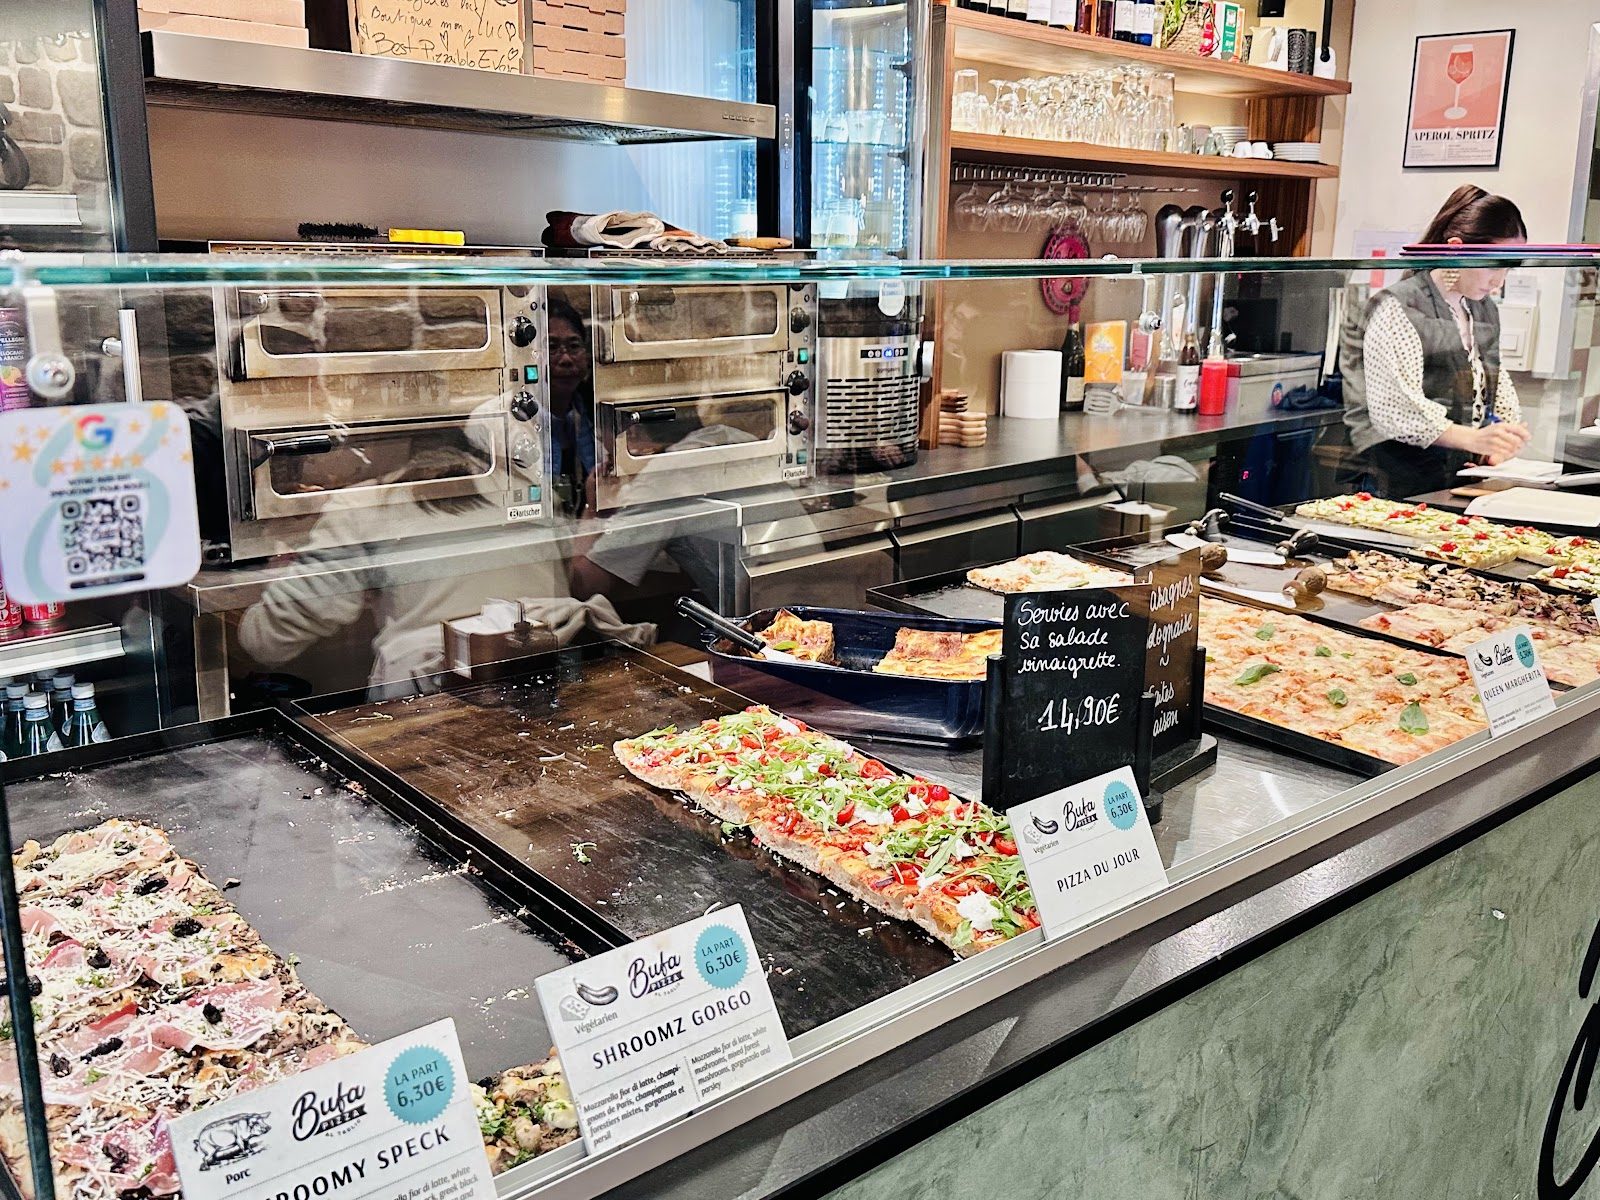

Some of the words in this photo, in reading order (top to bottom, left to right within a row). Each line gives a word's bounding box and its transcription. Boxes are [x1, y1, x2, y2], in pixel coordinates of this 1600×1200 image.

[370, 32, 419, 56] Best
[1413, 131, 1453, 142] APEROL
[1455, 129, 1496, 141] SPRITZ
[1017, 601, 1079, 626] Servies
[1085, 601, 1130, 620] avec
[1048, 626, 1109, 649] salade
[1017, 650, 1121, 680] vinaigrette.
[1483, 684, 1505, 701] QUEEN
[1504, 668, 1542, 690] MARGHERITA
[1037, 692, 1121, 735] 14,90€
[1152, 709, 1179, 738] aison
[1107, 795, 1117, 804] LA
[1115, 791, 1129, 802] PART
[1110, 801, 1135, 819] 6,30€
[1062, 797, 1096, 832] Bufa
[1056, 868, 1092, 892] PIZZA
[1093, 860, 1110, 877] DU
[1113, 848, 1141, 869] JOUR
[701, 946, 714, 957] LA
[713, 936, 734, 952] PART
[627, 951, 682, 999] Bufa
[705, 949, 743, 975] 6,30€
[574, 1011, 618, 1035] Végétarien
[592, 1017, 687, 1070] SHROOMZ
[691, 990, 752, 1027] GORGO
[691, 1046, 722, 1065] Mozzarella
[721, 1042, 731, 1054] fior
[731, 1038, 738, 1047] di
[737, 1033, 753, 1044] latte,
[752, 1026, 767, 1037] white
[694, 1056, 728, 1075] mushrooms,
[727, 1046, 744, 1060] mixed
[743, 1040, 760, 1055] forest
[394, 1073, 410, 1086] LA
[411, 1060, 439, 1080] PART
[697, 1066, 731, 1085] mushrooms,
[730, 1051, 760, 1072] gorgonzola
[759, 1044, 771, 1056] and
[396, 1075, 448, 1108] 6,30€
[583, 1092, 619, 1113] Mozzarella
[619, 1087, 631, 1100] fior
[631, 1083, 639, 1092] di
[639, 1076, 656, 1089] latte,
[656, 1064, 680, 1080] champi-
[586, 1111, 607, 1126] gnons
[607, 1106, 616, 1115] de
[616, 1098, 635, 1111] Paris,
[635, 1080, 675, 1102] champignons
[701, 1081, 721, 1098] parsley
[291, 1081, 366, 1142] Bufa
[321, 1108, 361, 1131] PIZZA
[590, 1116, 621, 1137] forestiers
[621, 1107, 644, 1121] mixtes,
[644, 1090, 678, 1112] gorgonzola
[678, 1086, 685, 1094] et
[376, 1124, 451, 1170] SPECK
[593, 1130, 612, 1147] persil
[225, 1167, 252, 1185] Porc
[422, 1182, 430, 1193] di
[431, 1175, 451, 1189] latte,
[451, 1166, 472, 1180] white
[439, 1182, 459, 1200] greek
[459, 1173, 479, 1189] black
